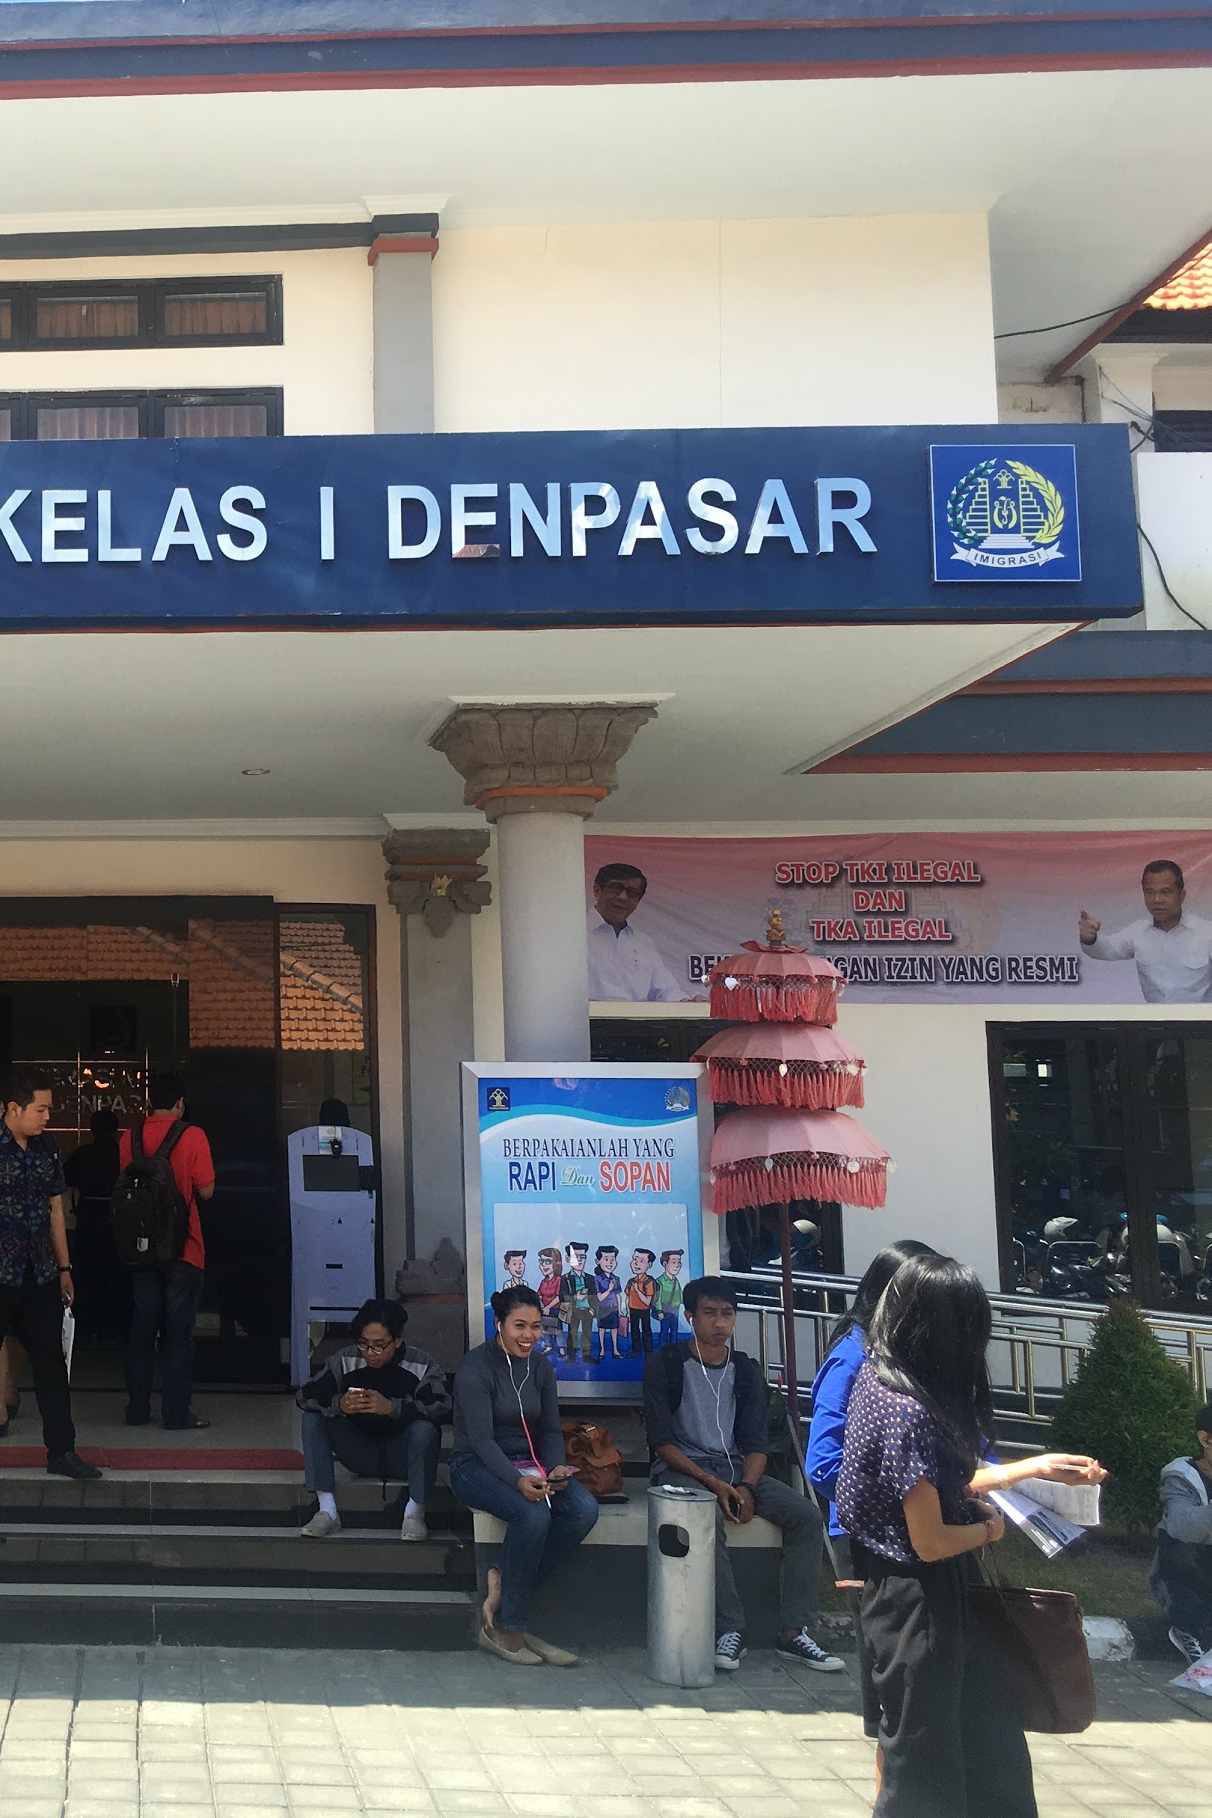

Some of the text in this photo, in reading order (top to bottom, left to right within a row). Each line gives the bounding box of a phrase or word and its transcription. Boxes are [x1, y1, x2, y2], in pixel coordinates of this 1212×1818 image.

[319, 486, 335, 560] I
[387, 477, 878, 559] DENPASAR
[974, 551, 1042, 565] IMIGRASI
[776, 861, 980, 883] STOP TKI ILEGAL
[853, 890, 905, 911] DAN
[810, 918, 952, 940] TKA ILEGAL
[884, 956, 935, 981] IZIN
[941, 956, 1000, 981] YANG
[1006, 955, 1078, 981] RESMI
[503, 1138, 675, 1158] BERPAKAIANLAH YANG
[508, 1160, 671, 1192] RAPI Dan SOPAN
